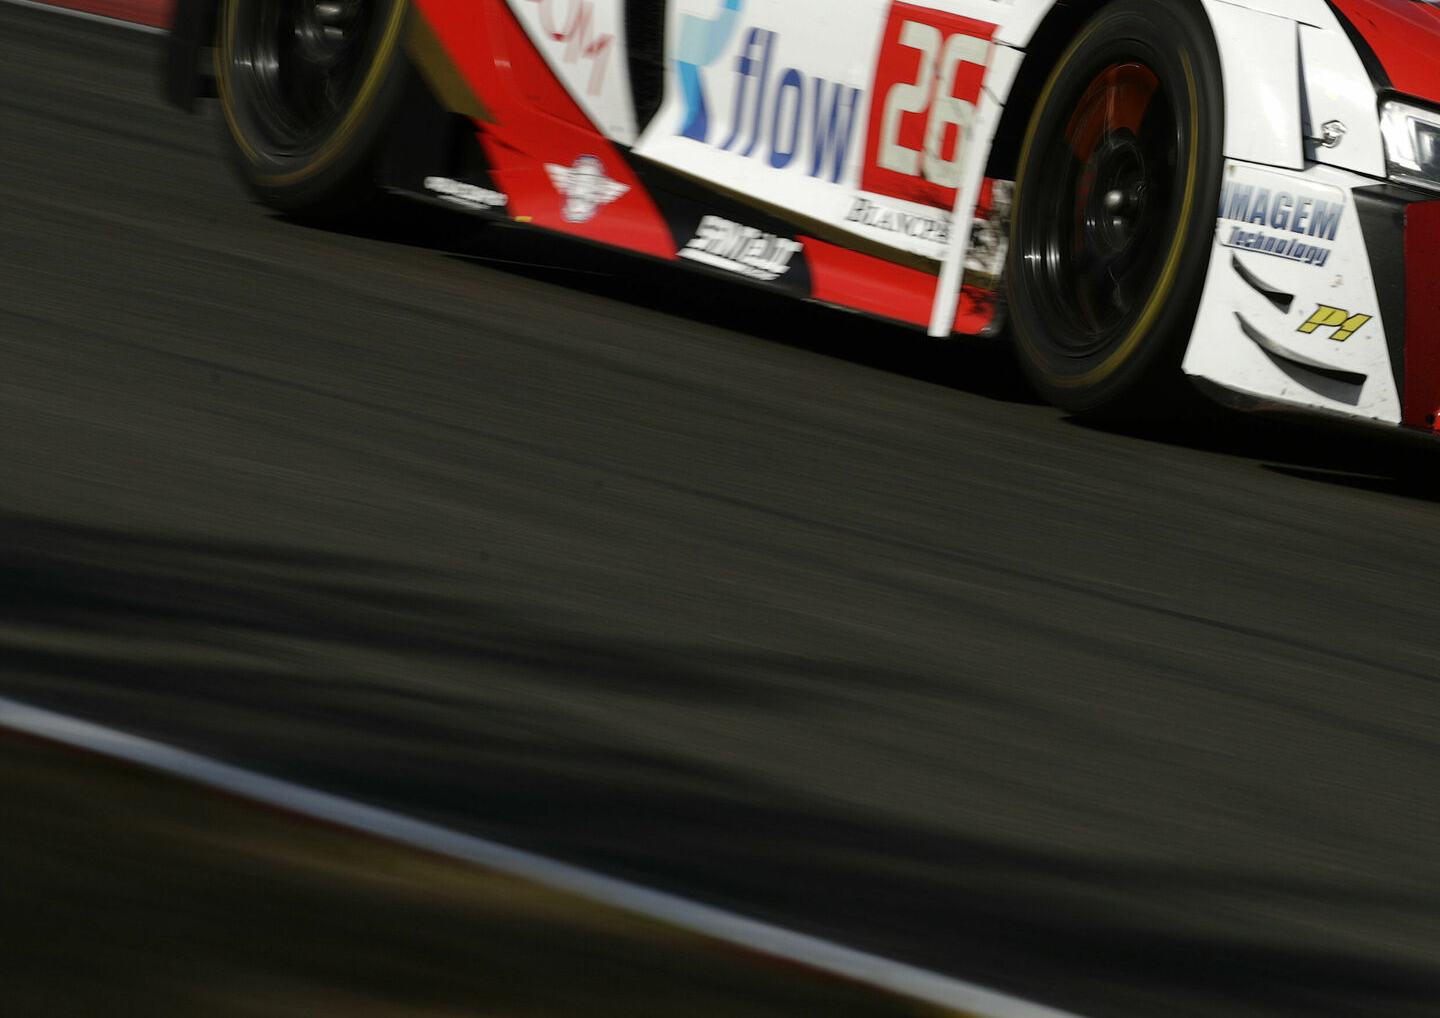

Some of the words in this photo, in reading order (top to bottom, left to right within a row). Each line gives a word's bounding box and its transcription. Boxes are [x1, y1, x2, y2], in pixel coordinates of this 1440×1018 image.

[877, 19, 992, 189] 26
[1216, 179, 1345, 242] IMAGEM
[1228, 225, 1332, 268] Technology
